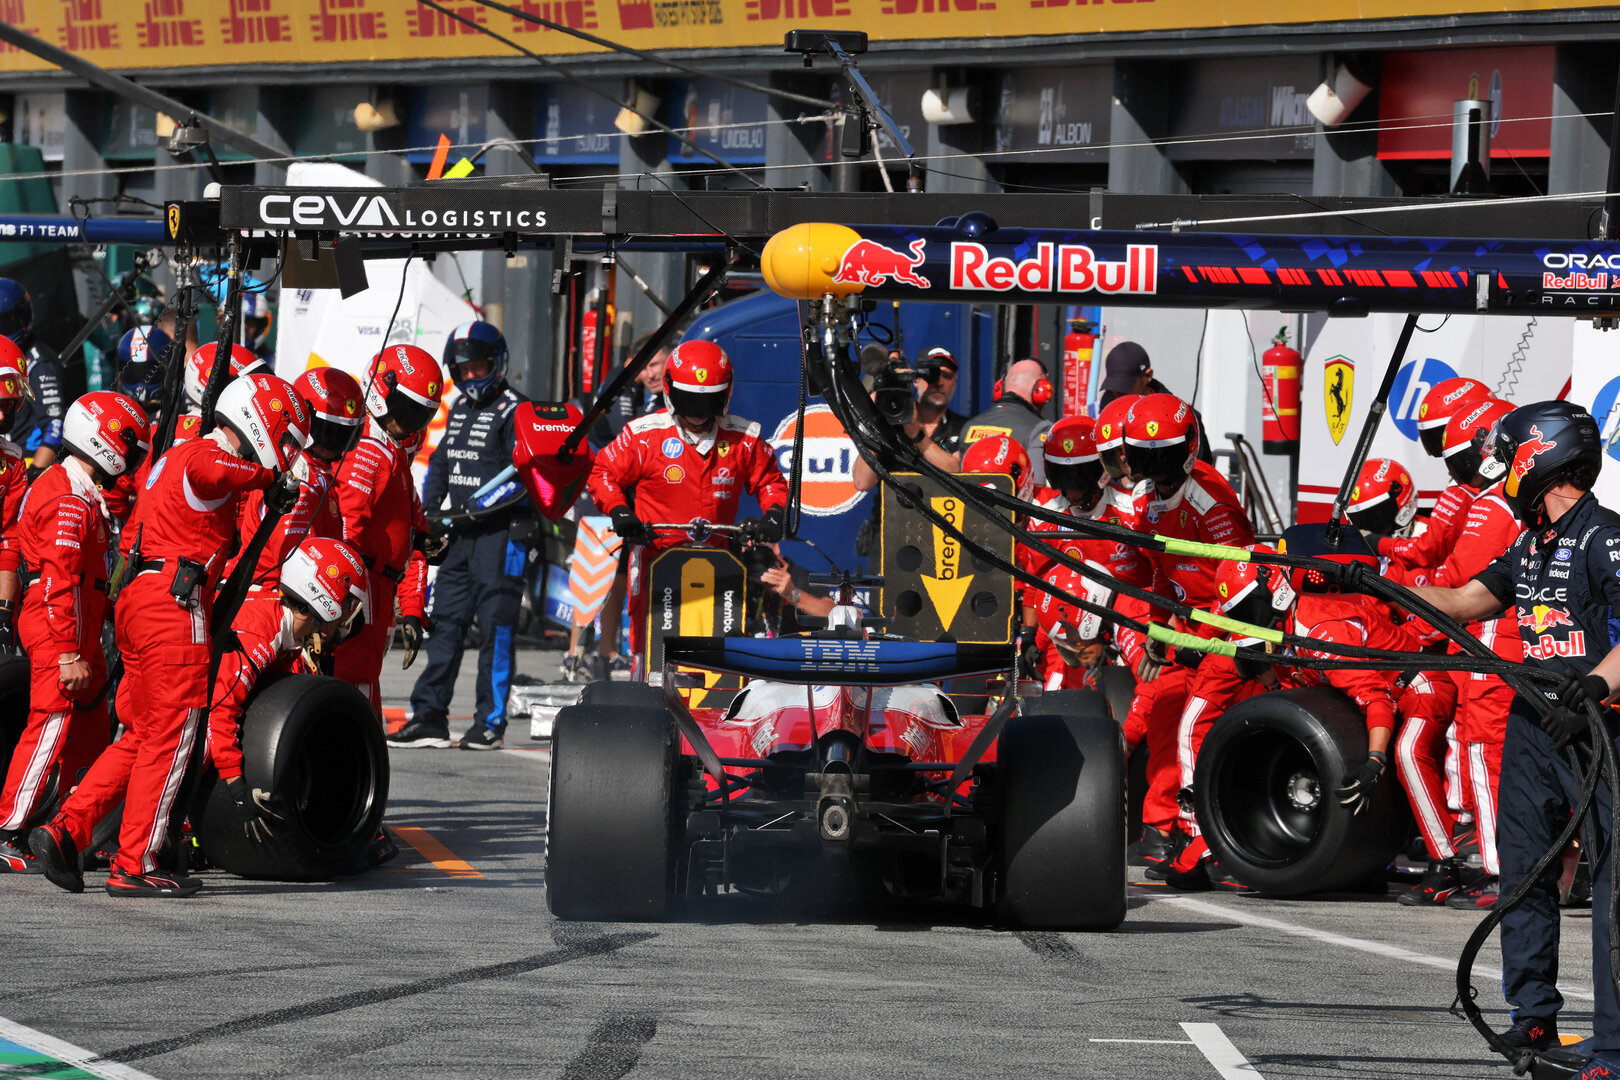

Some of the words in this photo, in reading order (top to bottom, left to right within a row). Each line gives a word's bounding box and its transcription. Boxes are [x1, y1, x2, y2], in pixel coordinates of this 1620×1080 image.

[1056, 123, 1092, 145] ALBON
[405, 210, 547, 226] LOGISTICS
[20, 225, 35, 236] F1
[38, 225, 79, 237] TEAM
[950, 242, 1053, 291] Red
[1058, 244, 1158, 294] Bull
[1543, 272, 1574, 289] Red
[1576, 272, 1608, 290] Bull
[357, 326, 381, 335] VISA
[1466, 401, 1494, 423] UniCredit
[665, 440, 680, 458] hp
[355, 453, 379, 468] brembo
[774, 444, 850, 475] Gul
[58, 510, 82, 521] brembo
[1207, 521, 1232, 532] brembo
[661, 587, 673, 630] brembo
[723, 590, 735, 632] brembo
[1539, 630, 1587, 661] Bull
[801, 640, 881, 673] IBM
